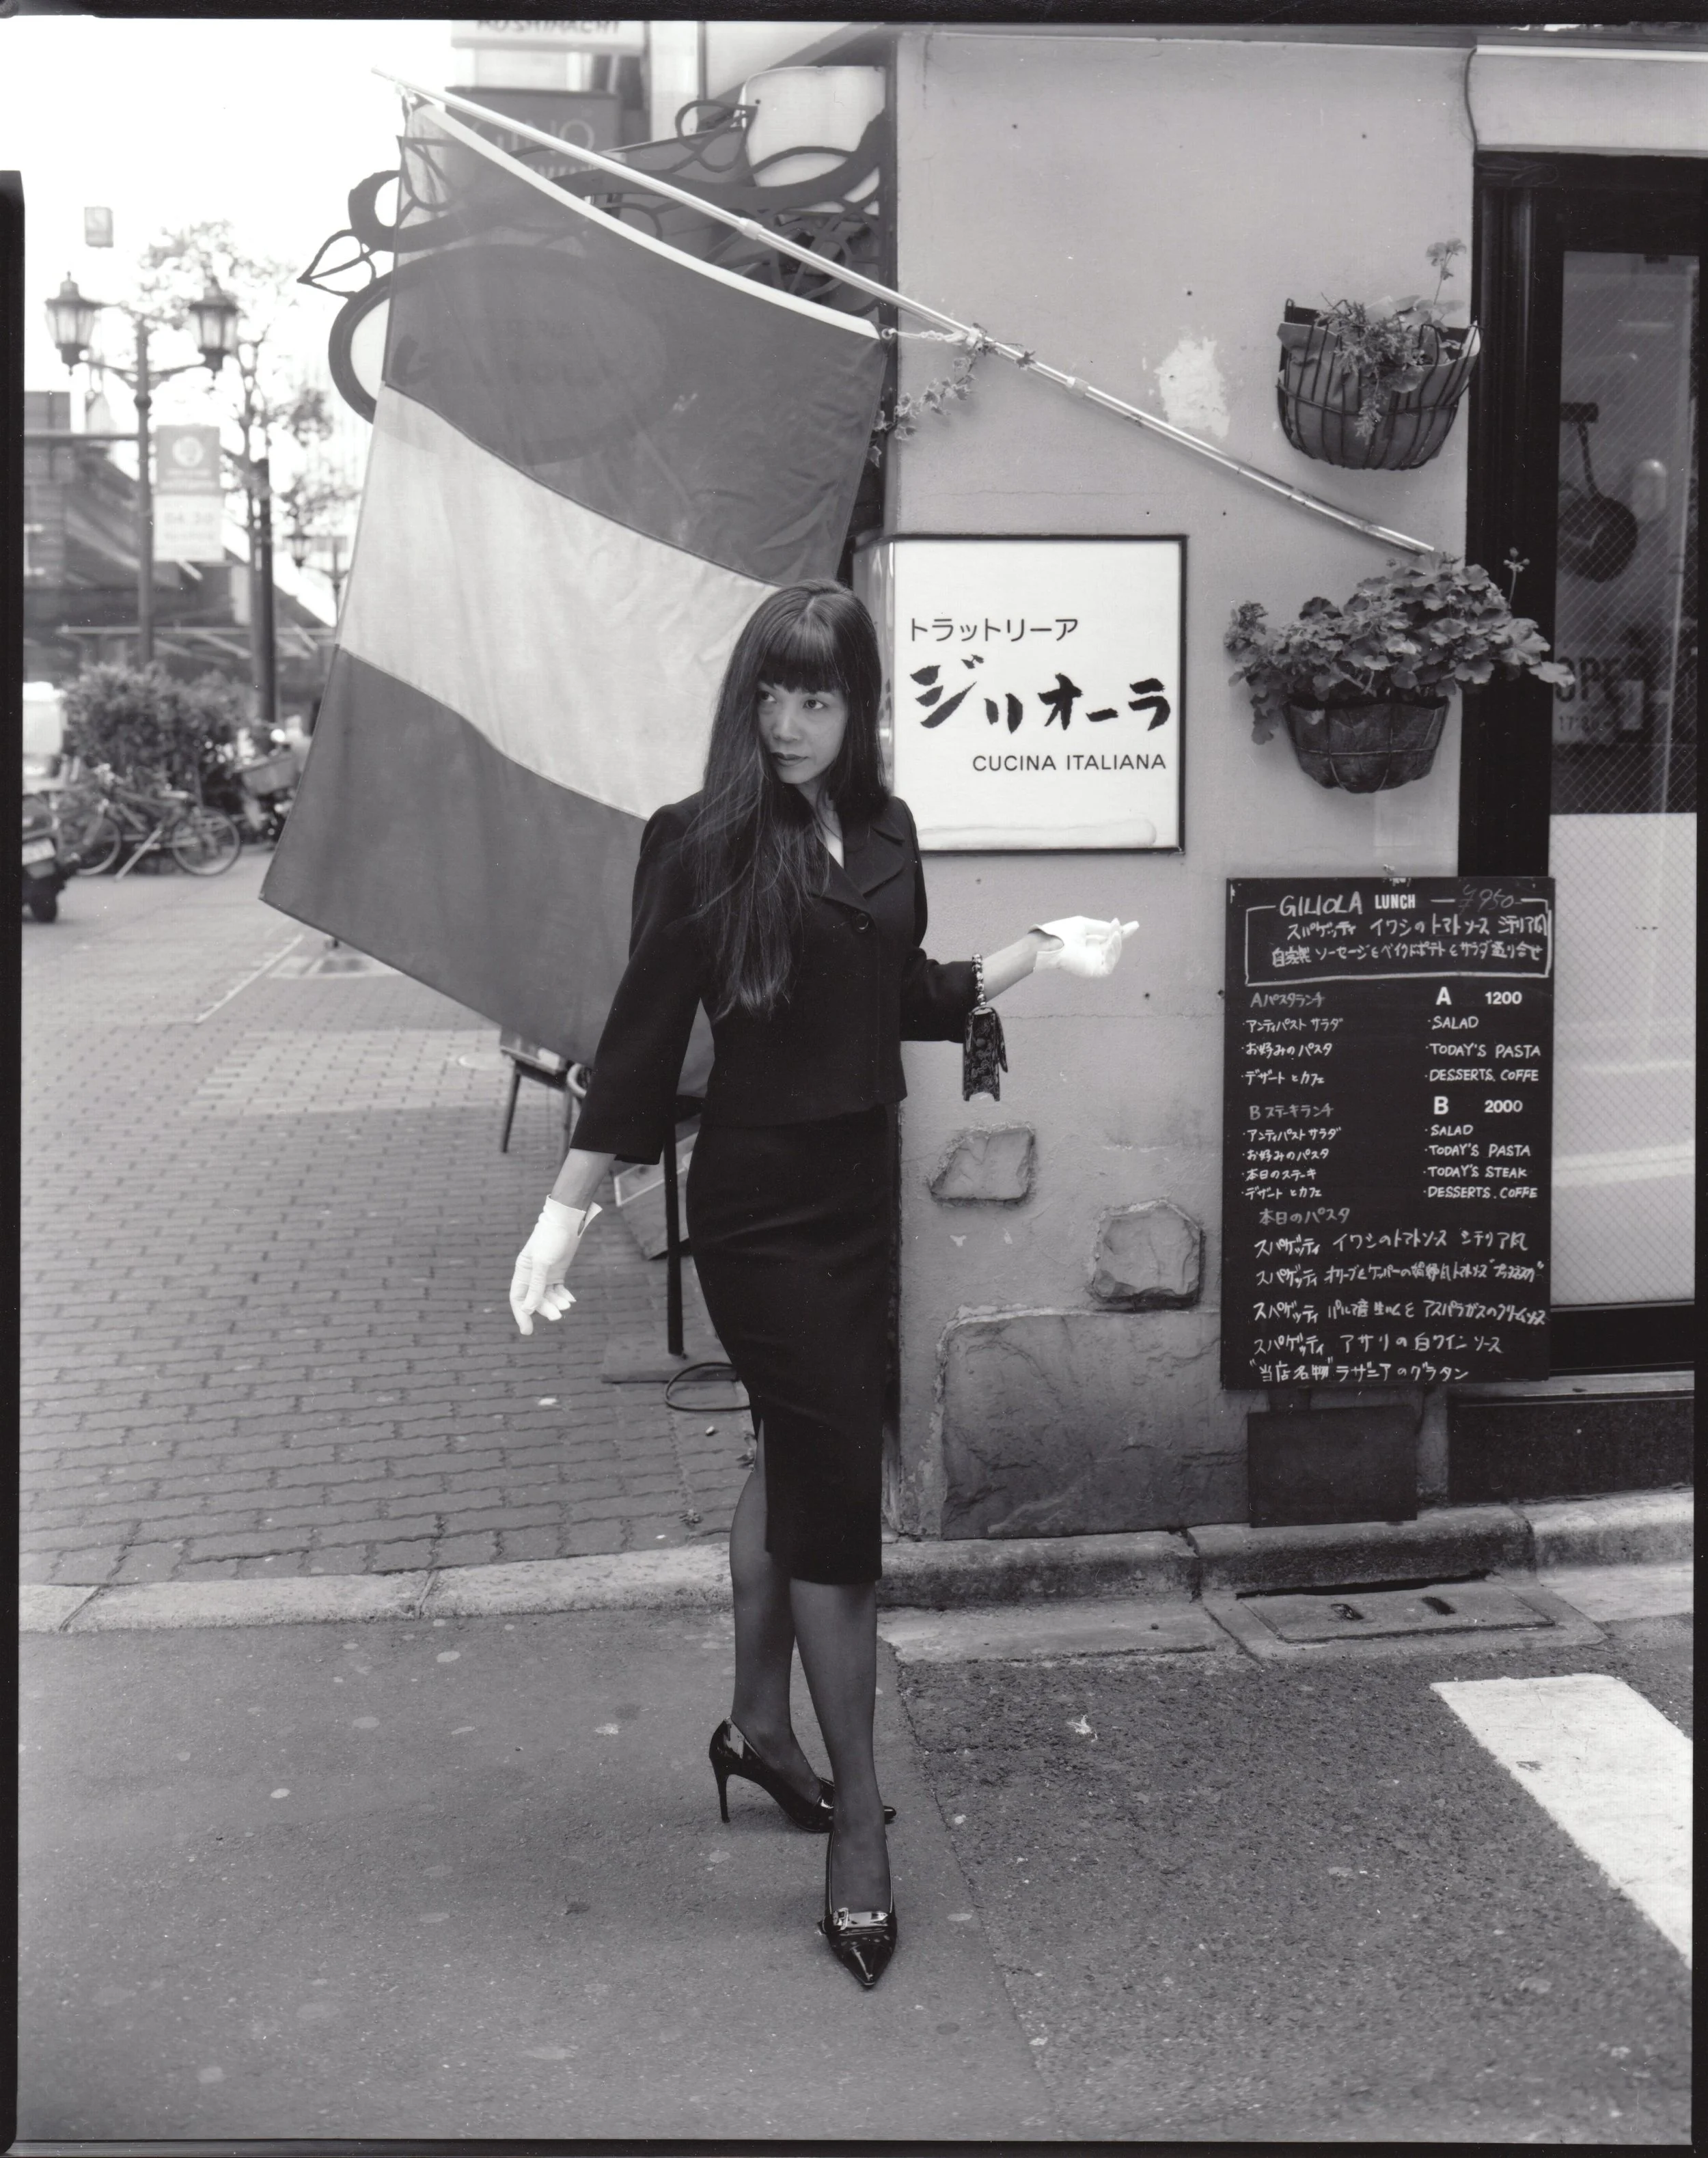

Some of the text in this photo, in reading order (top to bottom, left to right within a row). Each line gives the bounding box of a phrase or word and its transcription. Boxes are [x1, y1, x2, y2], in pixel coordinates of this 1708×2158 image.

[911, 618, 1078, 642] トラットリーア
[910, 655, 1171, 734] ジリオーラ
[973, 753, 1166, 771] CUCINA ITALIANA
[1375, 894, 1416, 910] LUNCH
[1435, 986, 1452, 1006] A
[1485, 991, 1523, 1005] 1200
[1310, 1017, 1344, 1032] サラダ
[1431, 1015, 1479, 1030] SALAD
[1429, 1042, 1541, 1059] TODAY'S PASTA
[1245, 1068, 1285, 1085] デザート
[1433, 1096, 1449, 1115] B
[1485, 1099, 1523, 1113] 2000
[1431, 1124, 1474, 1137] SALAD
[1247, 1148, 1330, 1163] お好みのパスタ
[1429, 1142, 1531, 1158] TODAY'S PASTA
[1245, 1167, 1317, 1182] 本日のステーキ
[1427, 1163, 1528, 1178] TODAY'S STEAK
[1245, 1186, 1283, 1200] デザート
[1259, 1206, 1351, 1226] 本日のパスタ
[1254, 1234, 1321, 1258] スパゲッティ
[1256, 1264, 1317, 1288] スパゲッティ
[1253, 1300, 1319, 1323] スパゲッティ
[1254, 1332, 1324, 1357] スパゲッティ
